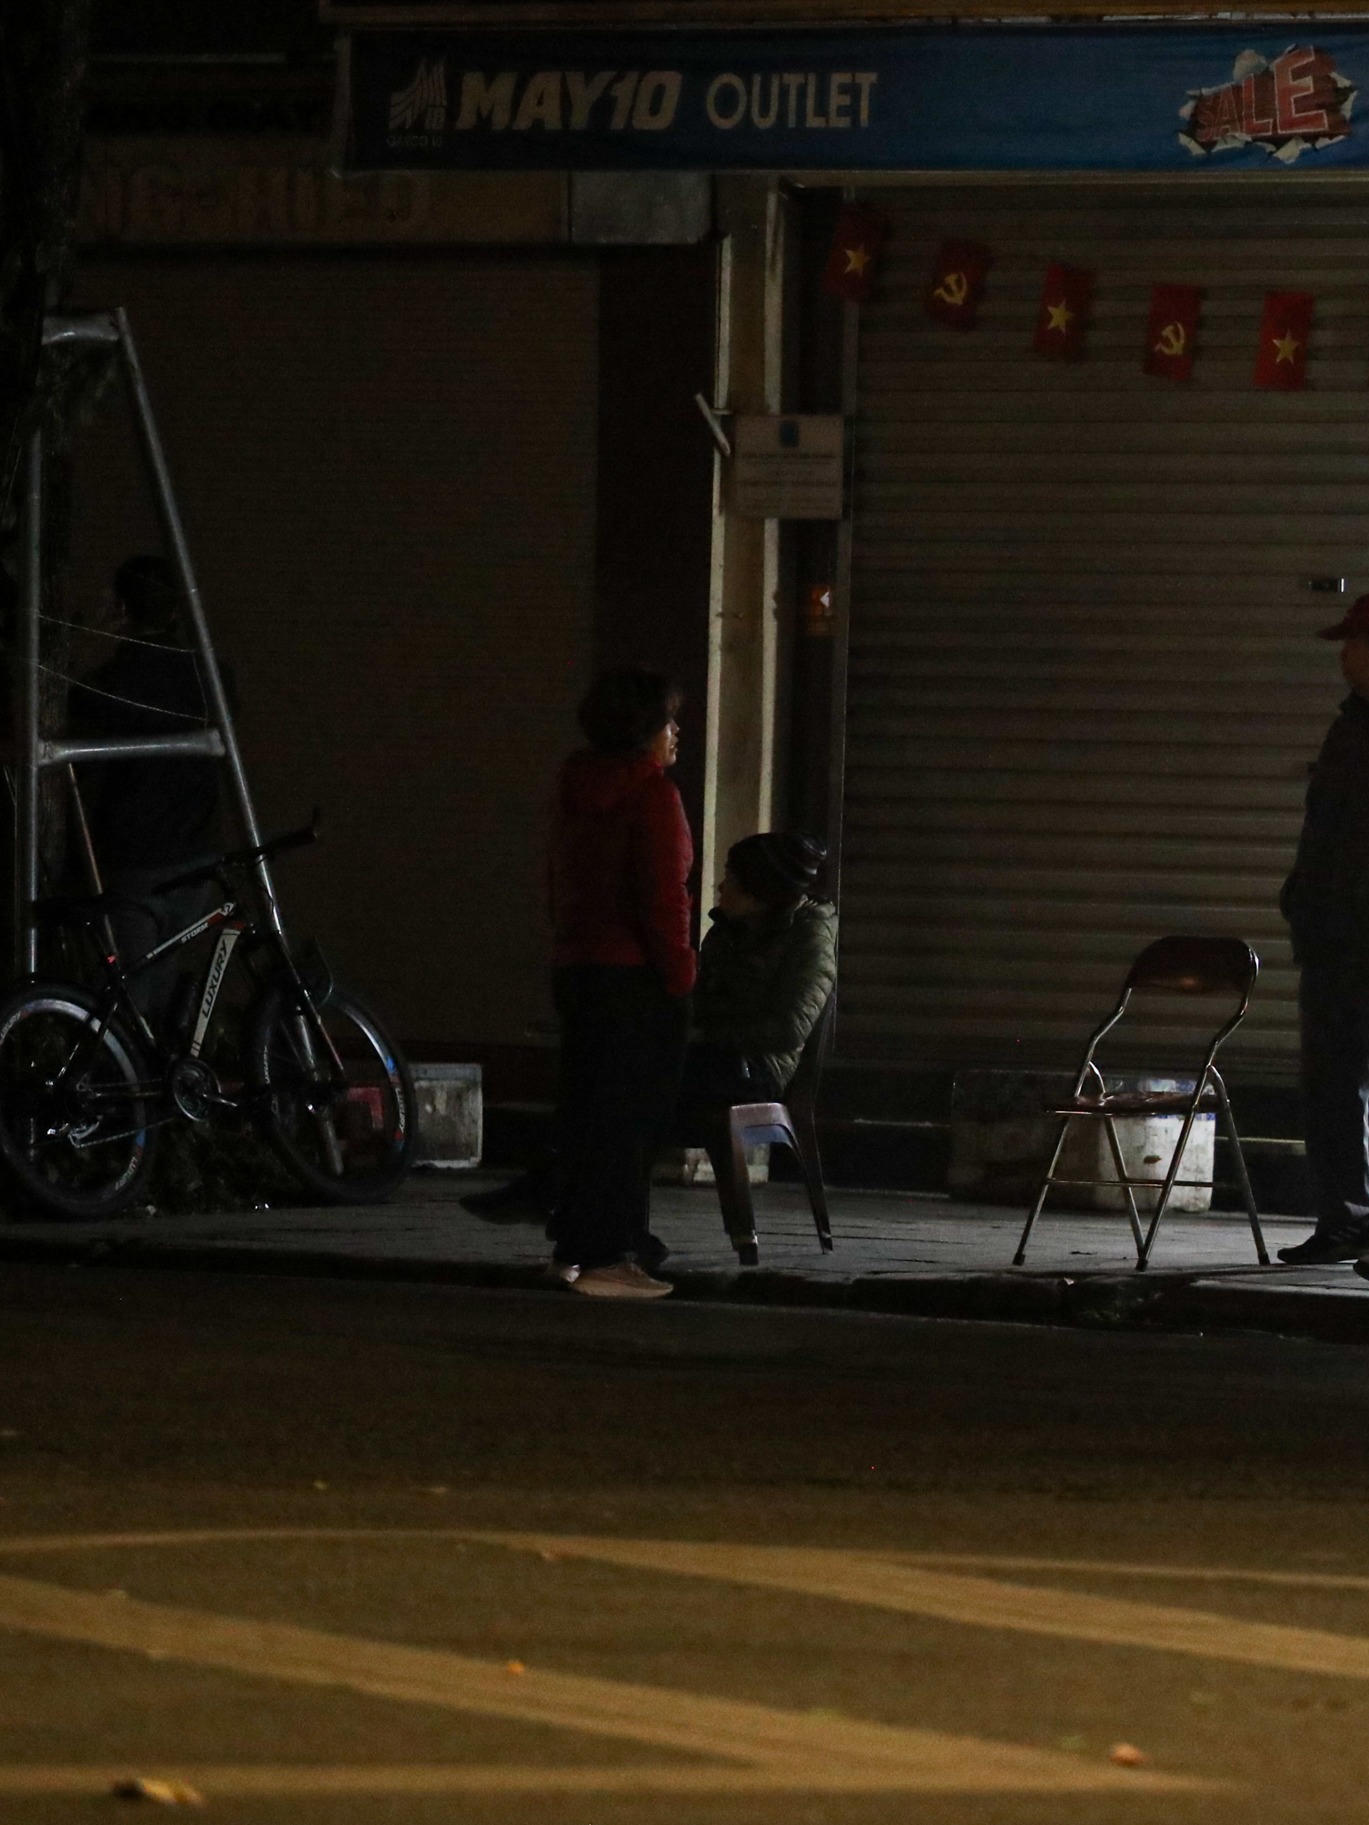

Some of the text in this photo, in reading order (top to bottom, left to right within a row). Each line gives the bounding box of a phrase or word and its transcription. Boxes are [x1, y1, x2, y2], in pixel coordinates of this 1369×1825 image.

[706, 71, 878, 129] OUTLET
[1198, 45, 1329, 142] SALE
[202, 937, 228, 1019] LUXURY
